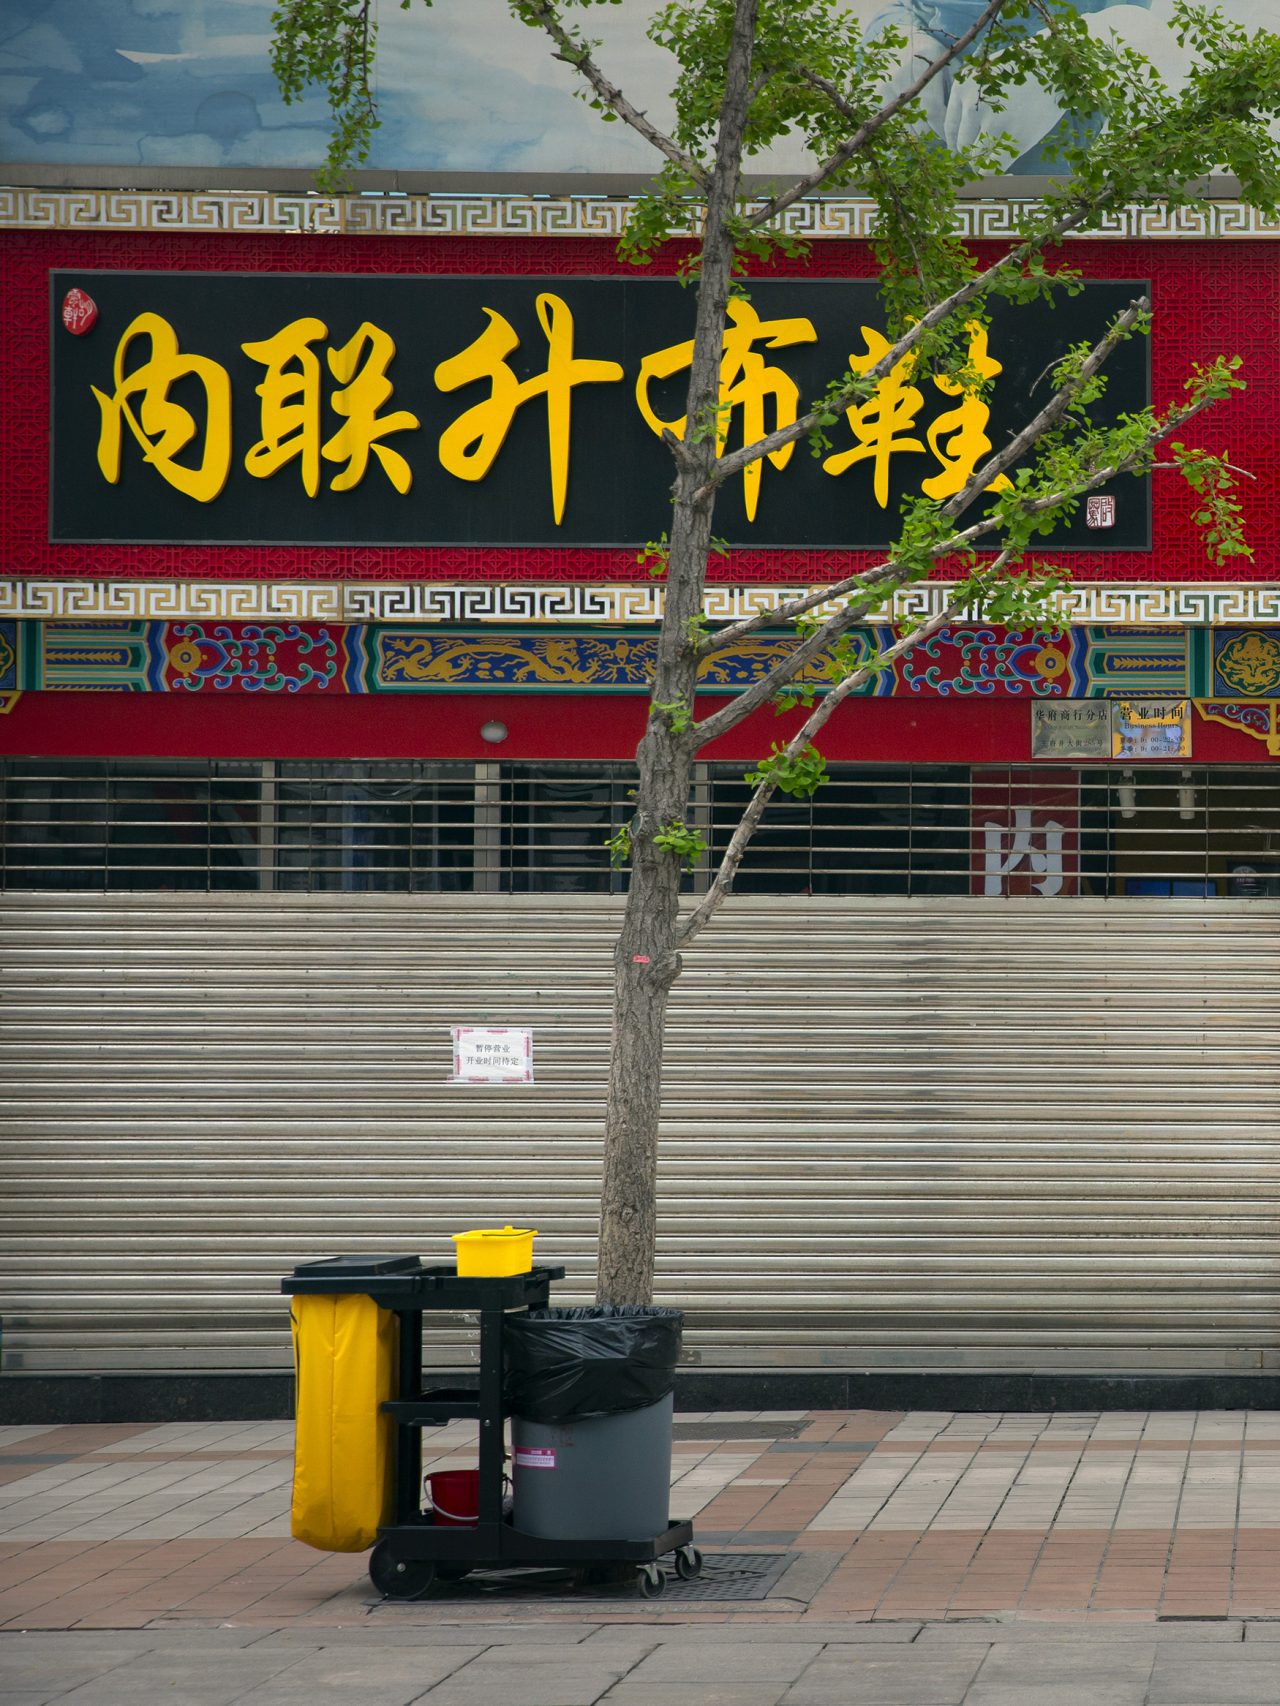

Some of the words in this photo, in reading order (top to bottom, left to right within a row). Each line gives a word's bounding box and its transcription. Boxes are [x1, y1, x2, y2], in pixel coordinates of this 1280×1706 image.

[1120, 706, 1183, 720] 营业时间
[1124, 722, 1156, 730] Business
[475, 1044, 511, 1053] 暂停营业
[466, 1056, 519, 1066] 开业时间待定
